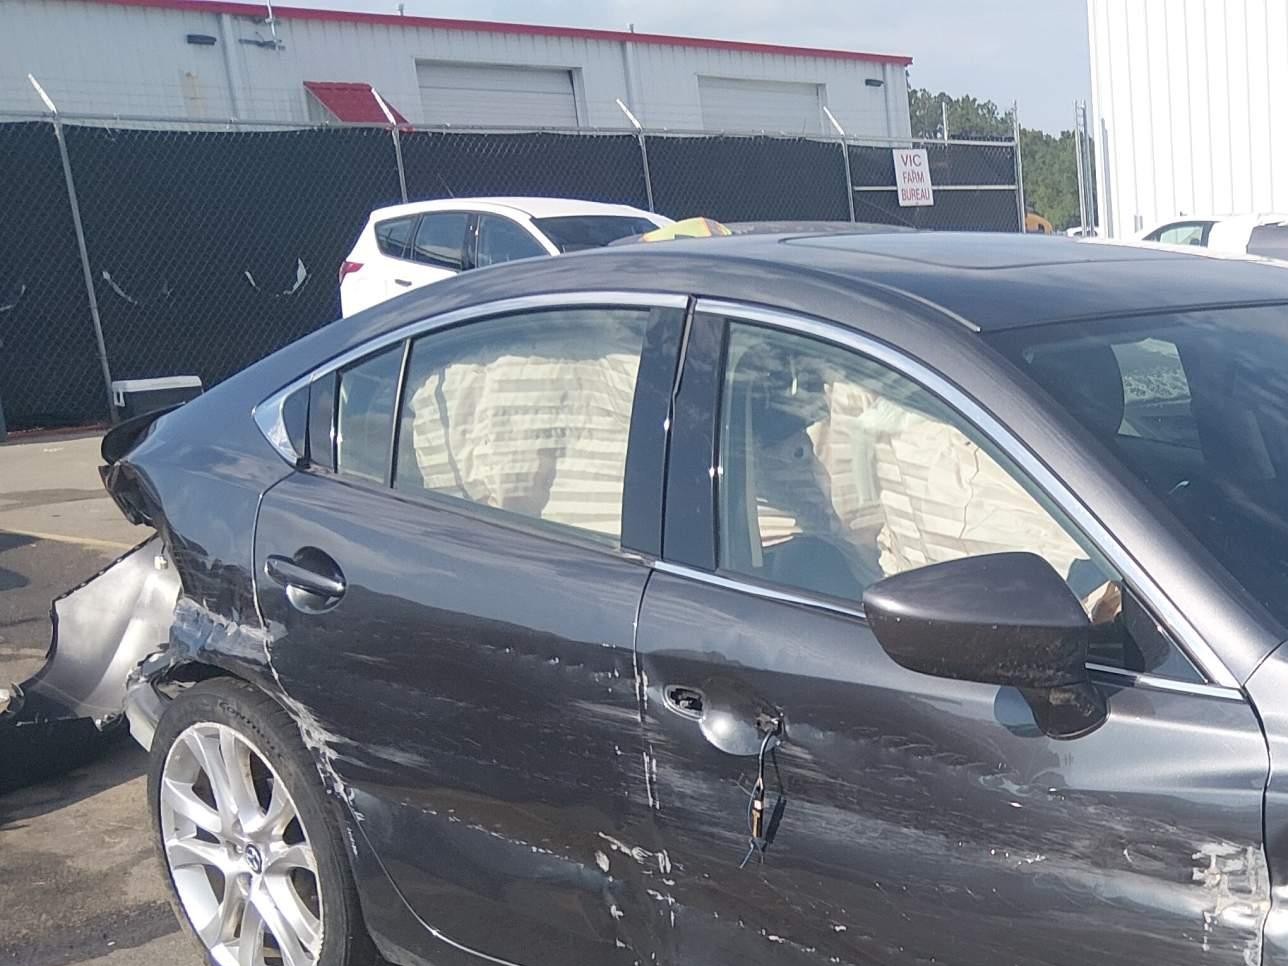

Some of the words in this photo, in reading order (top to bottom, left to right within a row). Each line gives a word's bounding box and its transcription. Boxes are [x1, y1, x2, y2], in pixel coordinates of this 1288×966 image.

[900, 154, 922, 167] VIC
[902, 171, 925, 184] FARM
[901, 187, 930, 201] BUREAU
